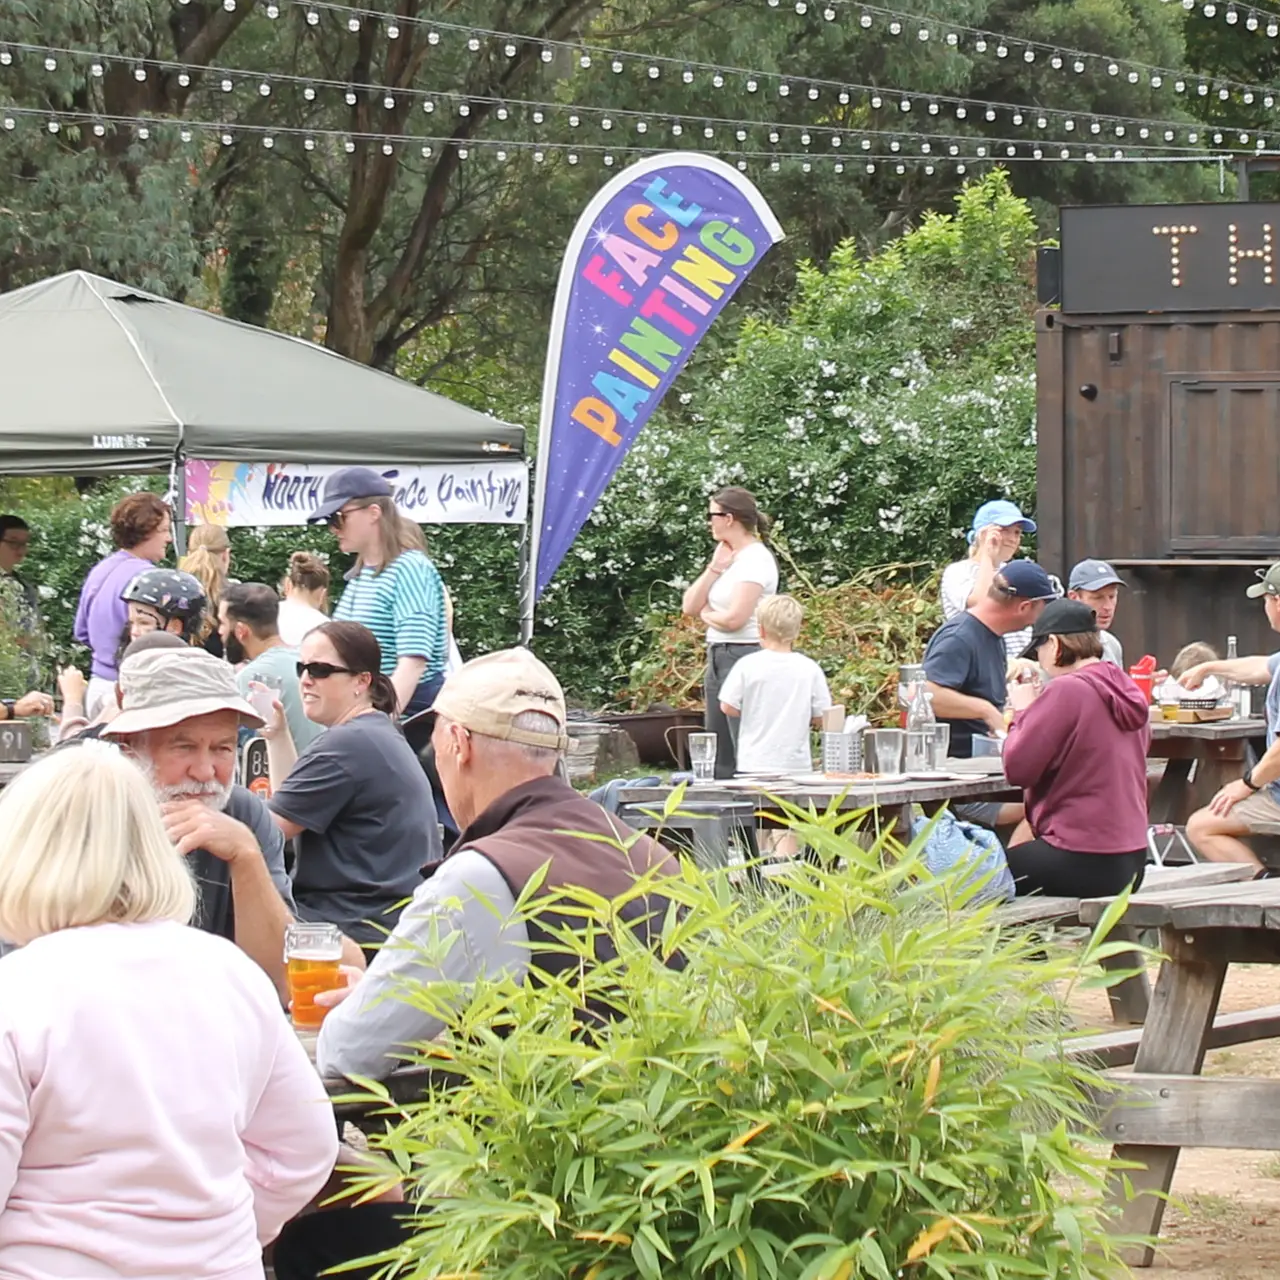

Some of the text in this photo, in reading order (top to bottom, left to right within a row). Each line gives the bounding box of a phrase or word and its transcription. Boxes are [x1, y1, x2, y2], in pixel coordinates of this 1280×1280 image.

[582, 176, 703, 308] FACE
[571, 220, 756, 448] PAINTING
[261, 470, 323, 511] NORTH
[2, 731, 23, 750] 91
